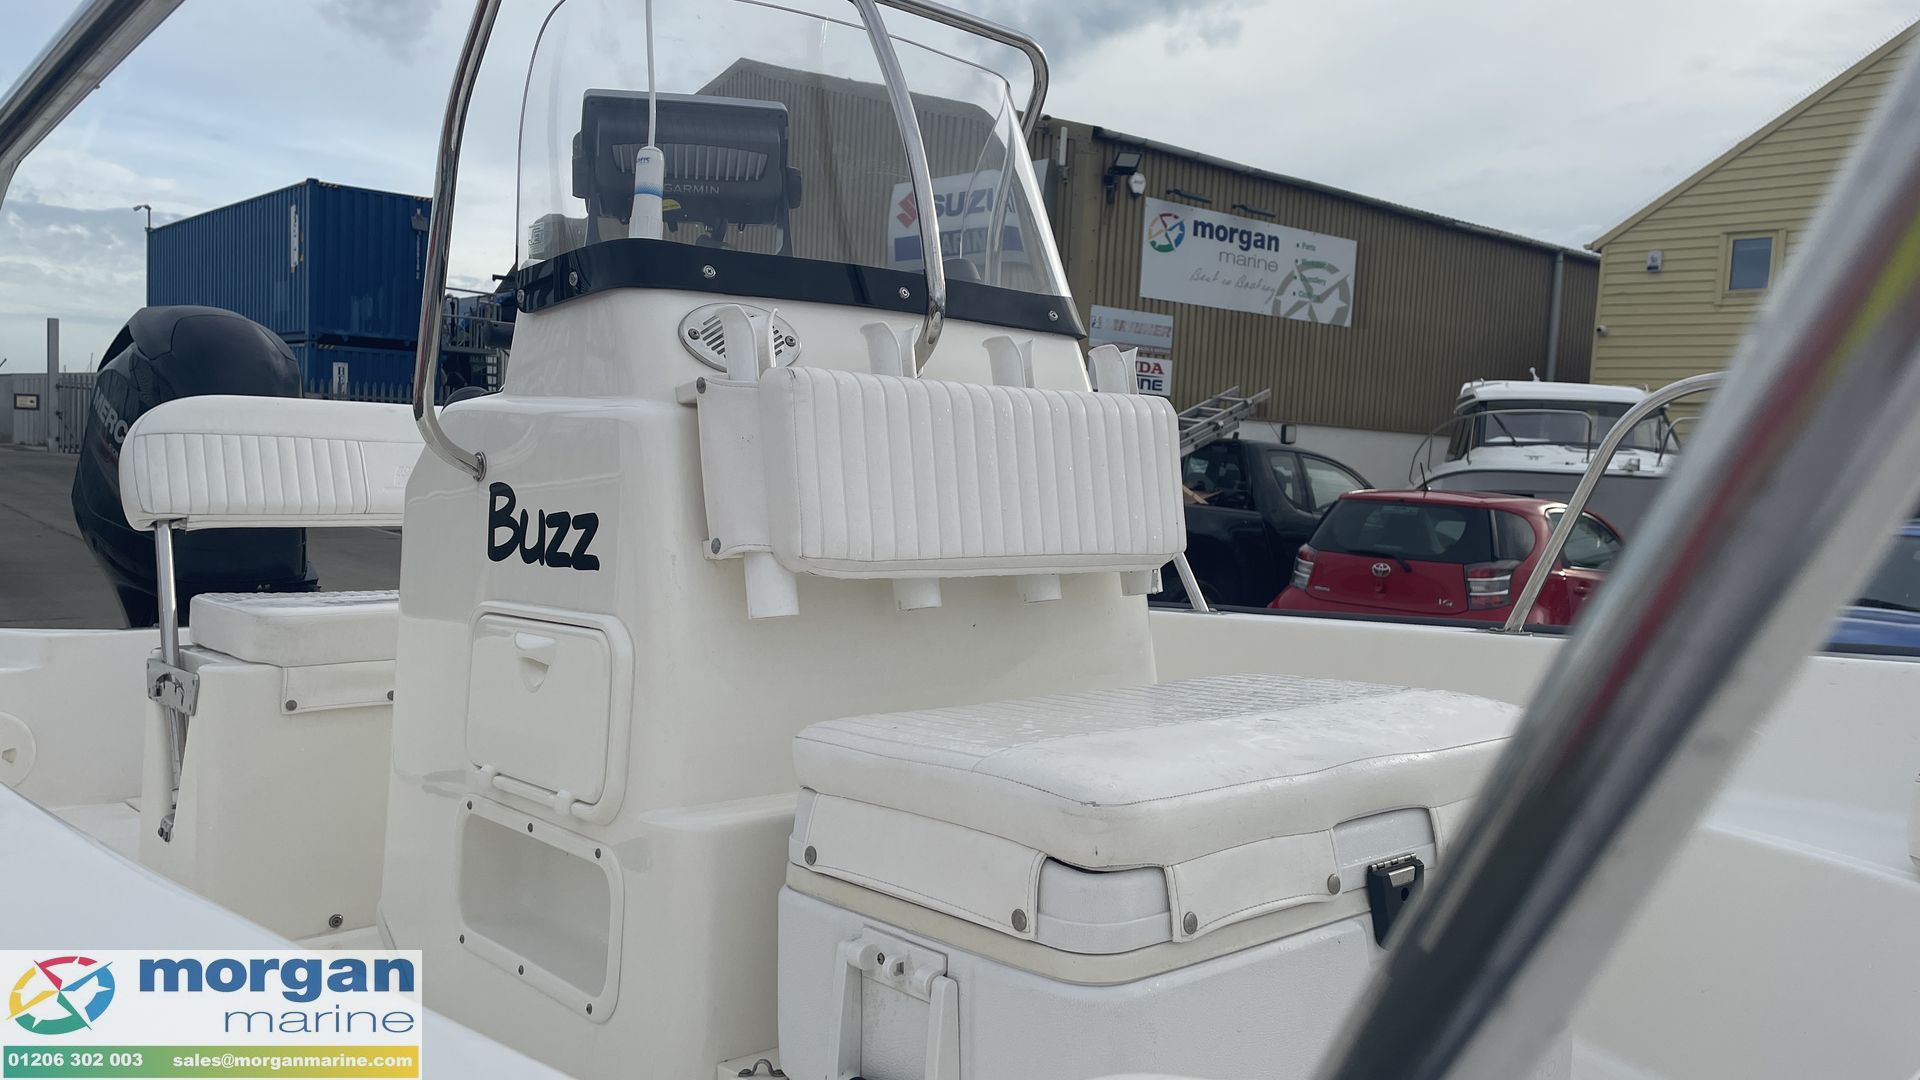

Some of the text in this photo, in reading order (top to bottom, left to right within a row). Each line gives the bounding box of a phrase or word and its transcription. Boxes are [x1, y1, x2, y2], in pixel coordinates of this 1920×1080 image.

[664, 183, 720, 195] GARMIN
[1193, 219, 1280, 253] morgan
[1218, 250, 1279, 273] marine
[93, 385, 129, 444] MERC
[488, 481, 600, 571] Buzz
